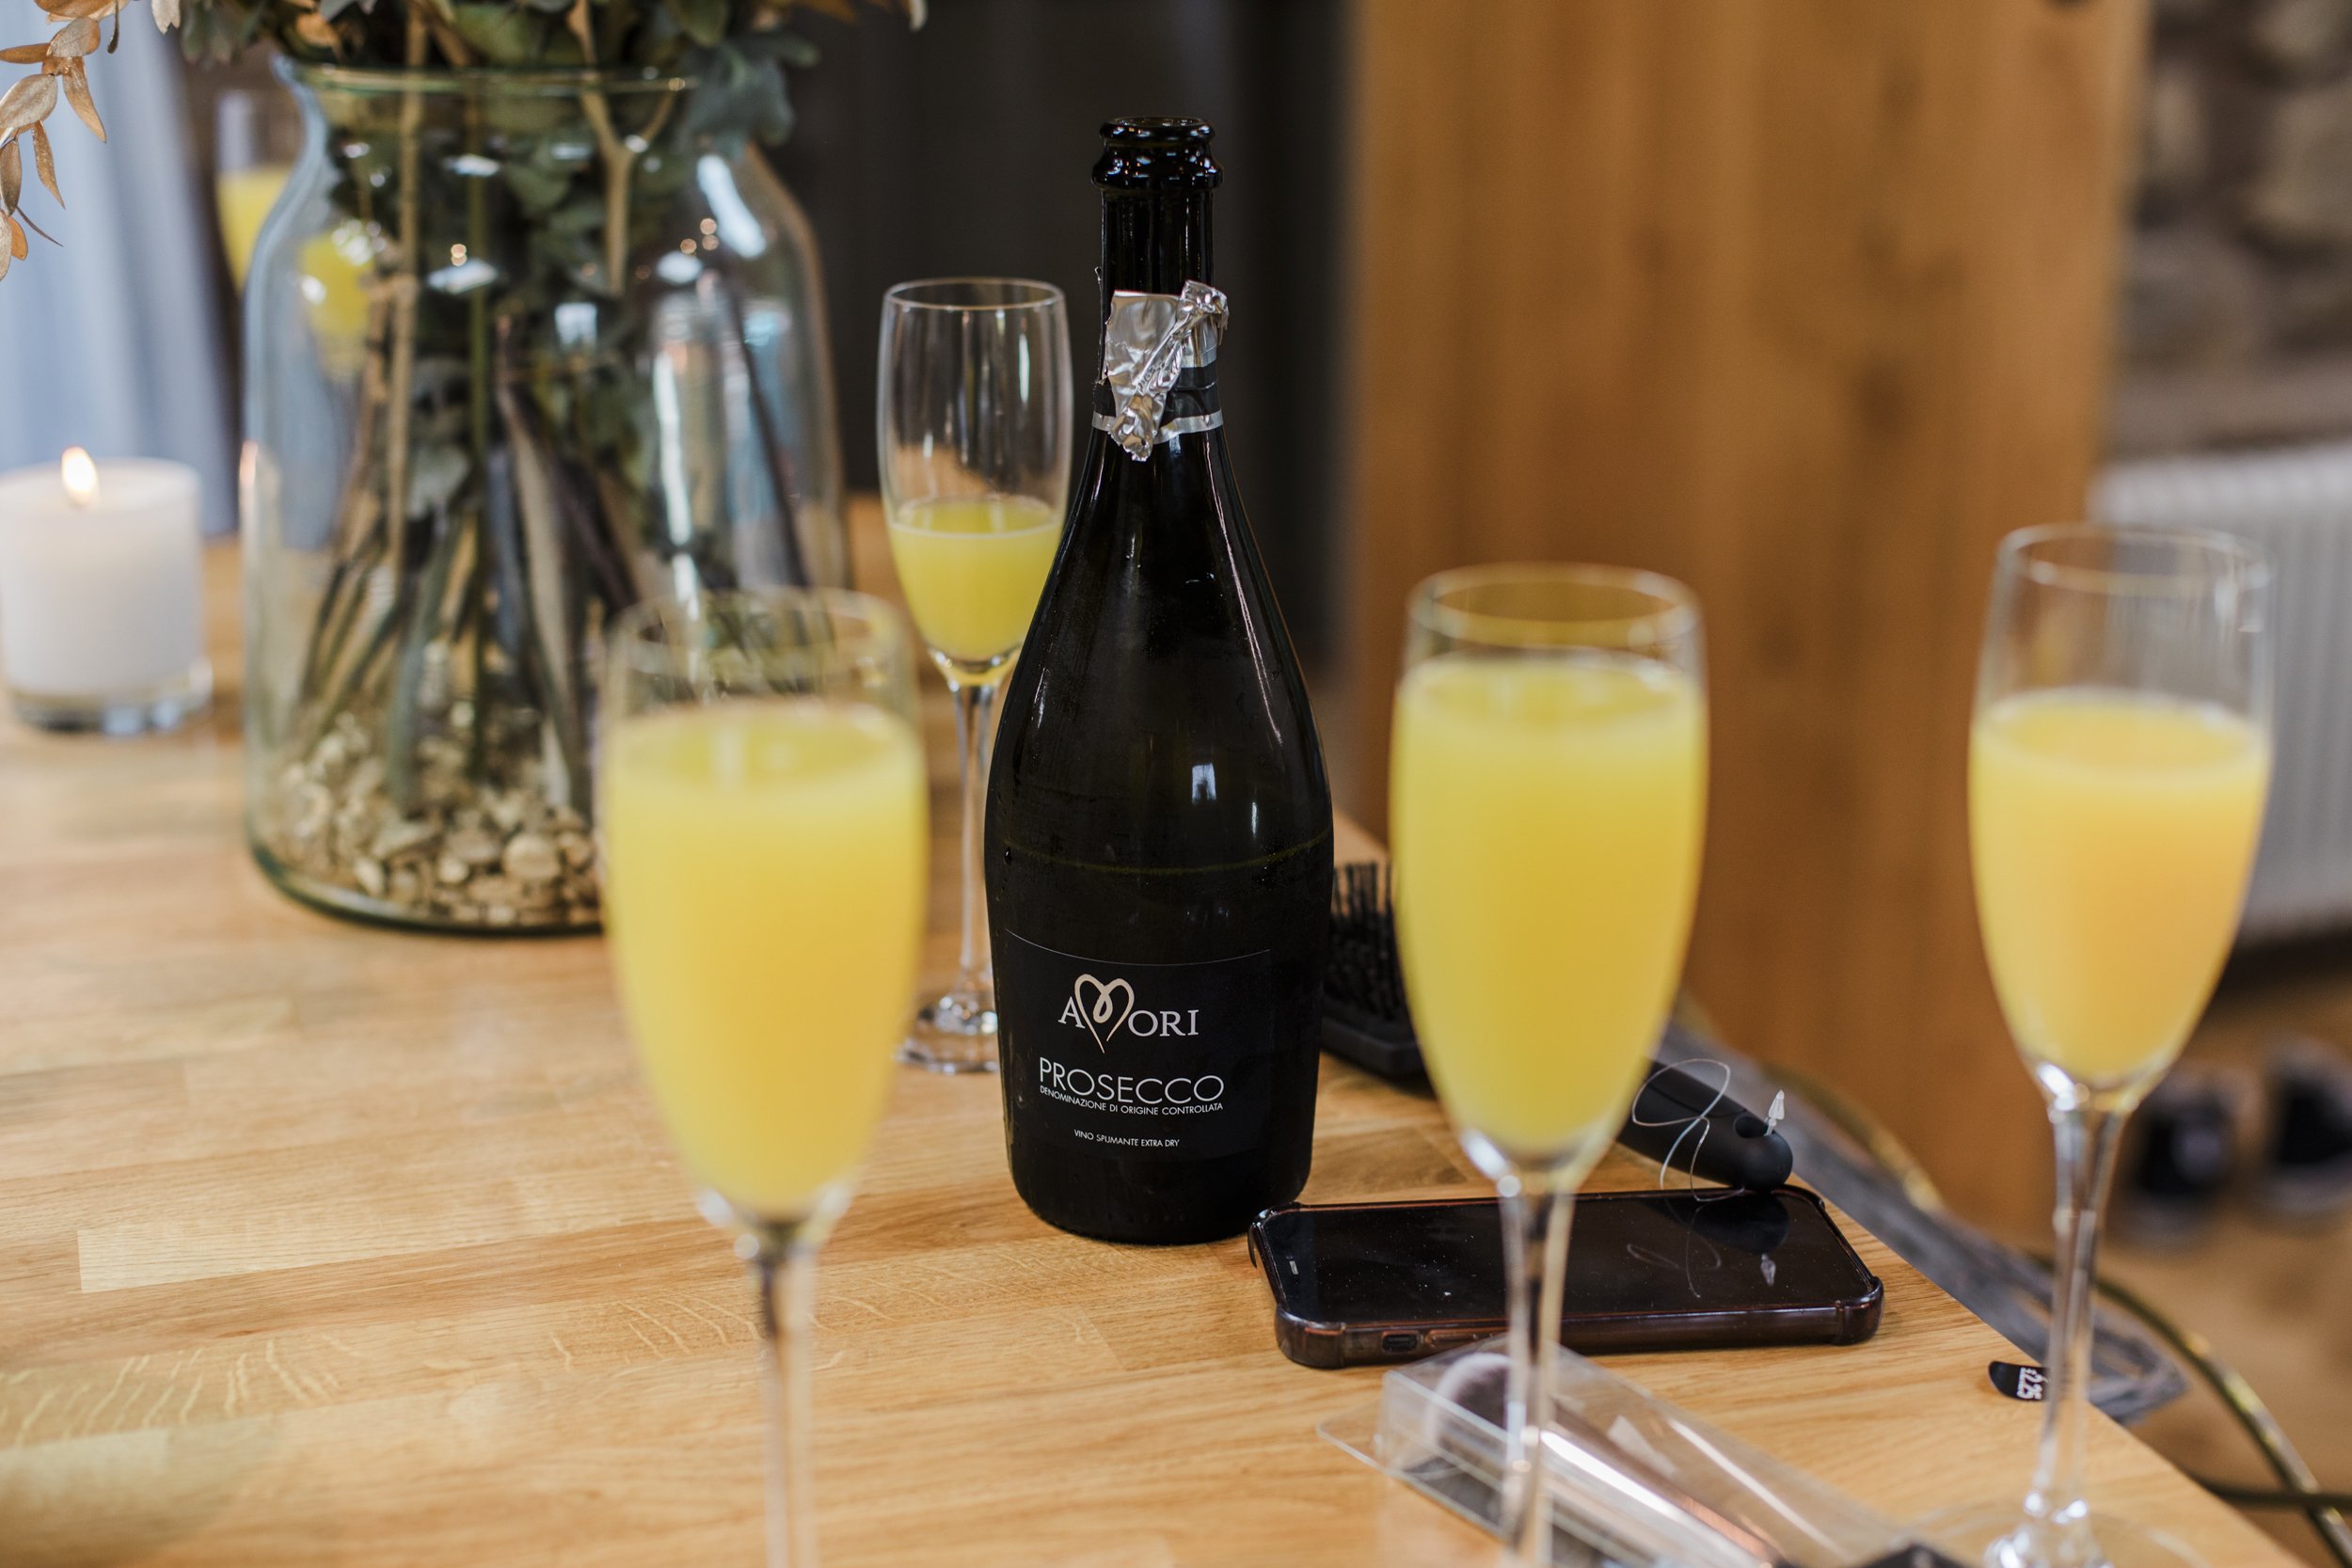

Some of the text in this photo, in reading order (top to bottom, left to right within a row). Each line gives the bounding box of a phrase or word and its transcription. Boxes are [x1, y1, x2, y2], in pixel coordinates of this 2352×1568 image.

[1057, 973, 1200, 1053] AMORI
[1040, 1056, 1224, 1104] PROSECCO
[1040, 1085, 1224, 1116] DENOMINAZIONE DI ORIGINE CONTROLLATA
[1073, 1129, 1180, 1148] VINO SPUMANTE EXTRA DRY
